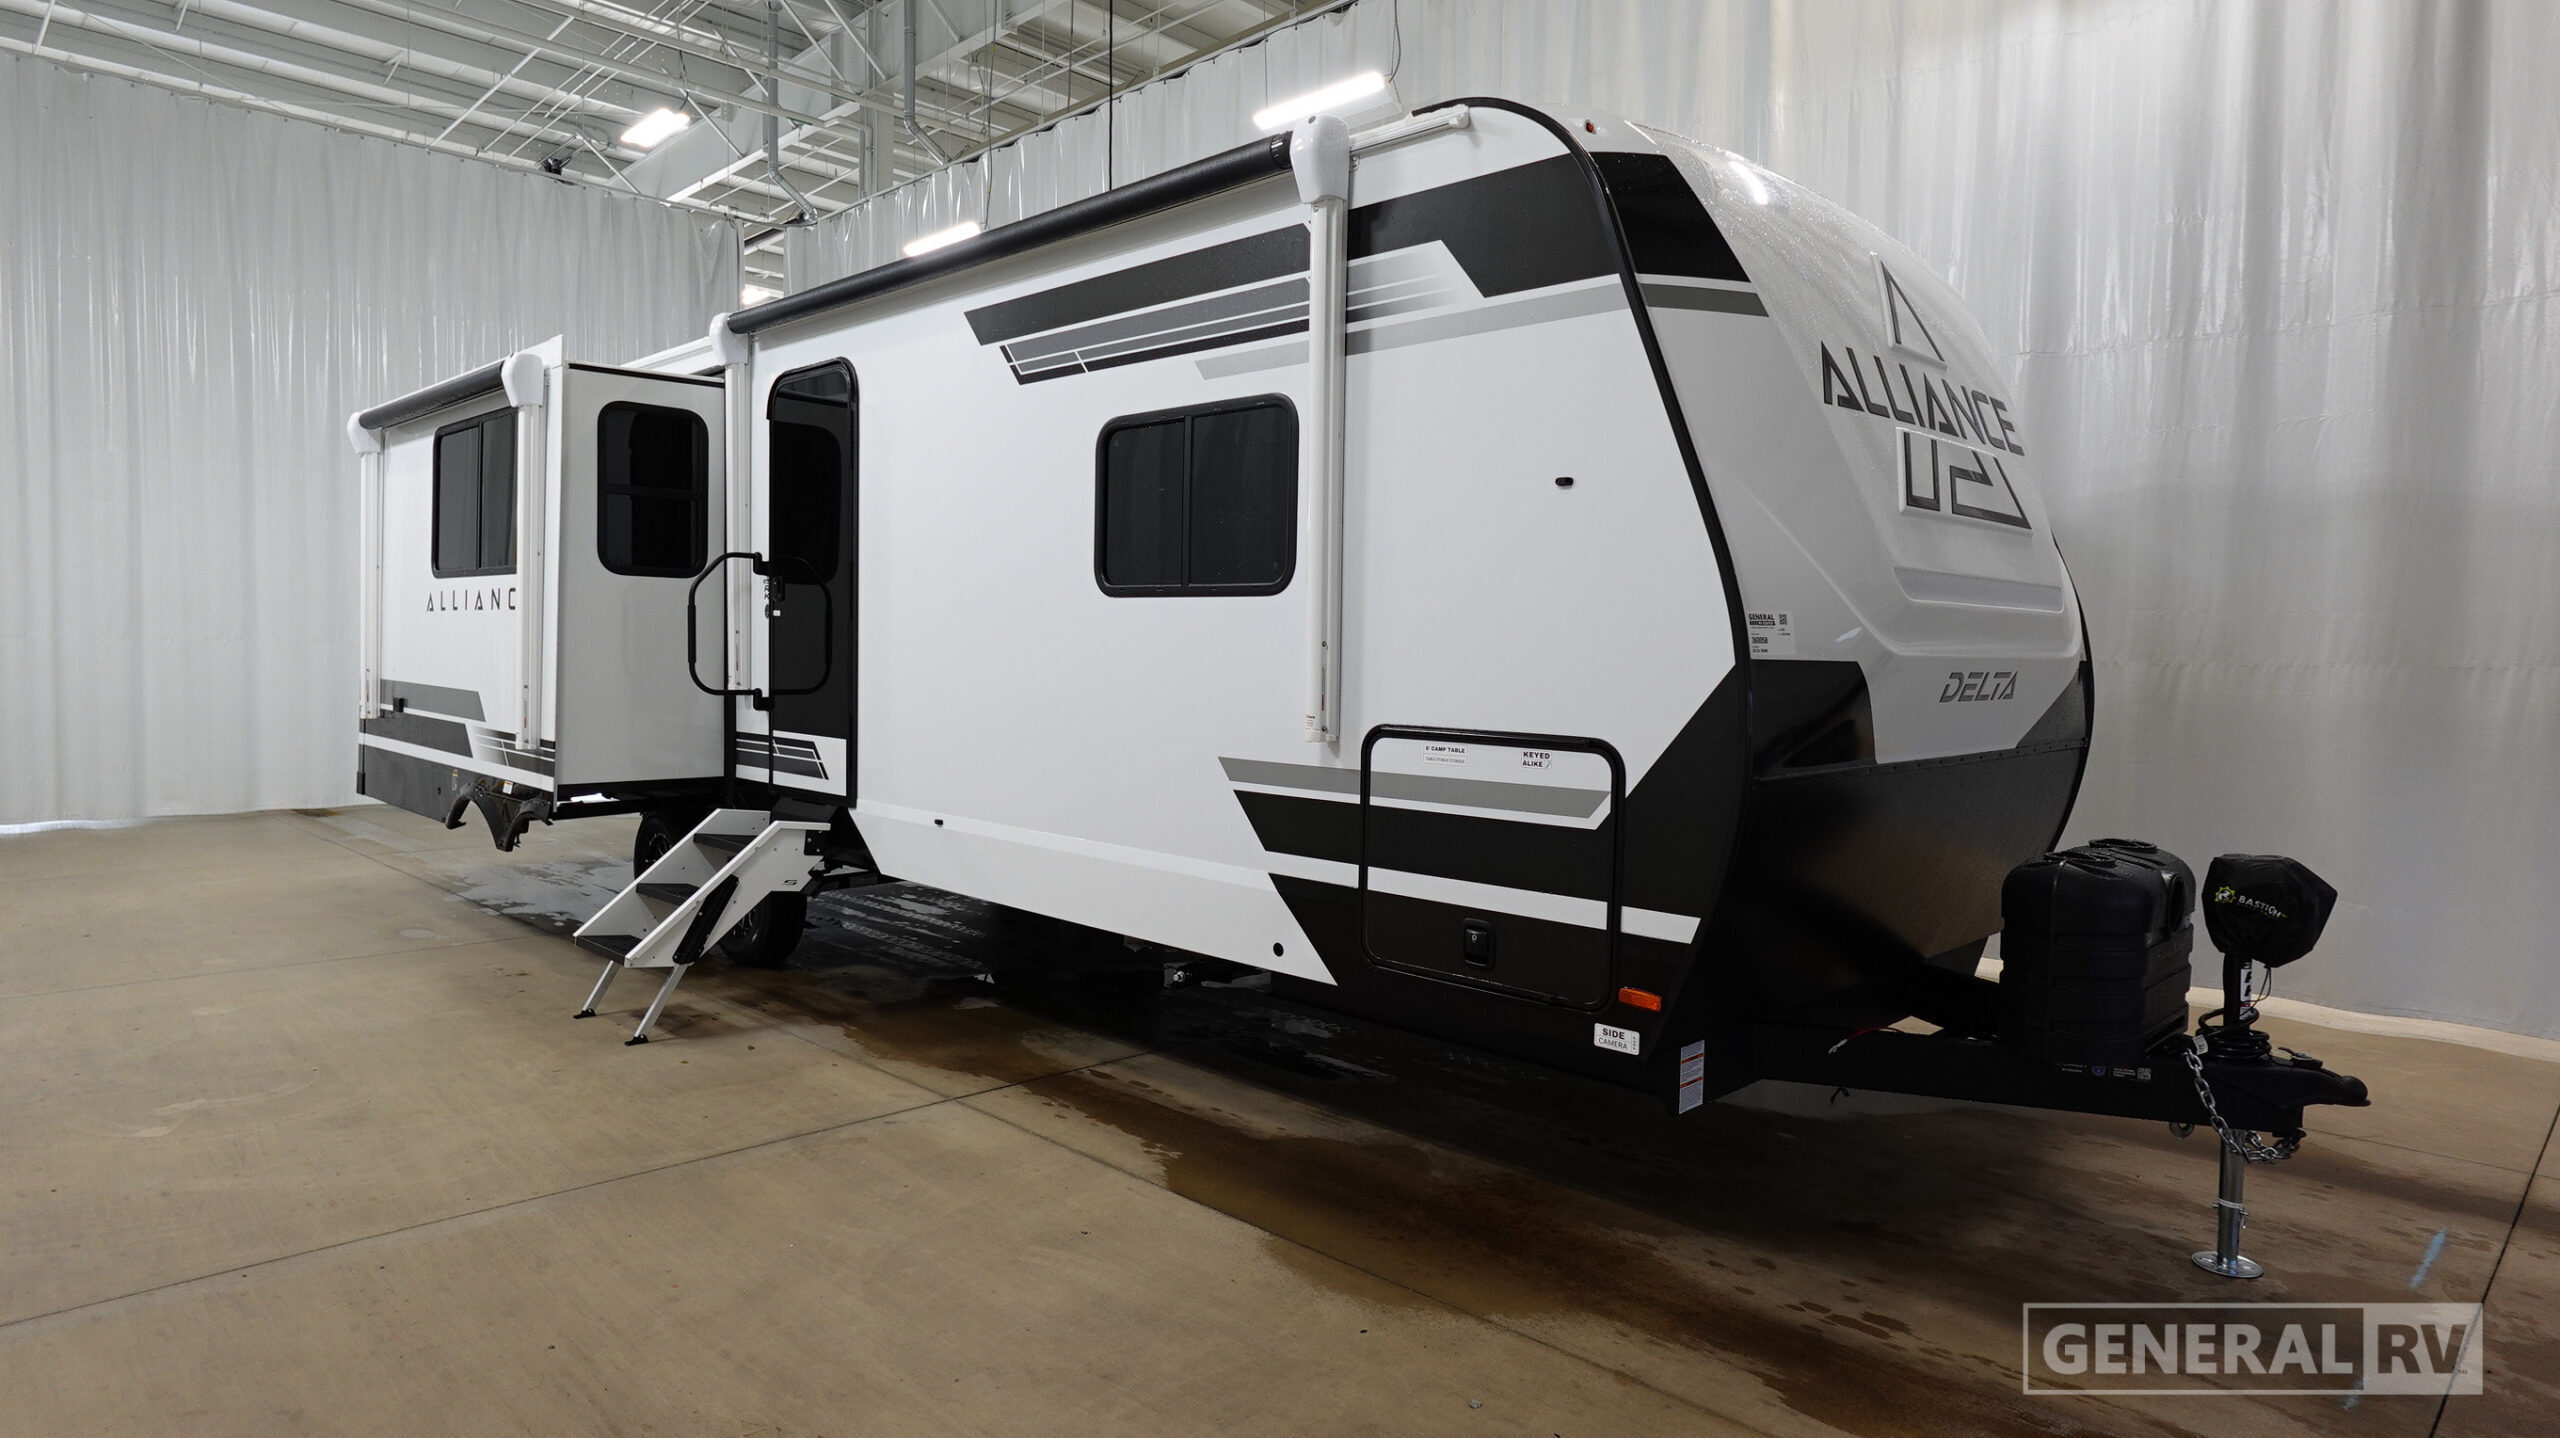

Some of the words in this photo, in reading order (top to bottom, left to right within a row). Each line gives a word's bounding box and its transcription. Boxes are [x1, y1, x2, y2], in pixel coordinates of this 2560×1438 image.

[1821, 340, 2025, 456] ALLIANCE
[426, 587, 517, 612] ALLIANC
[1748, 613, 1775, 621] GENERAL
[1939, 671, 2018, 703] DELTA
[1523, 751, 1550, 760] KEYED
[1522, 760, 1543, 768] ALIKE
[2238, 895, 2282, 918] BASTION
[1602, 1028, 1625, 1040] SIDE
[1598, 1037, 1628, 1050] CAMERA
